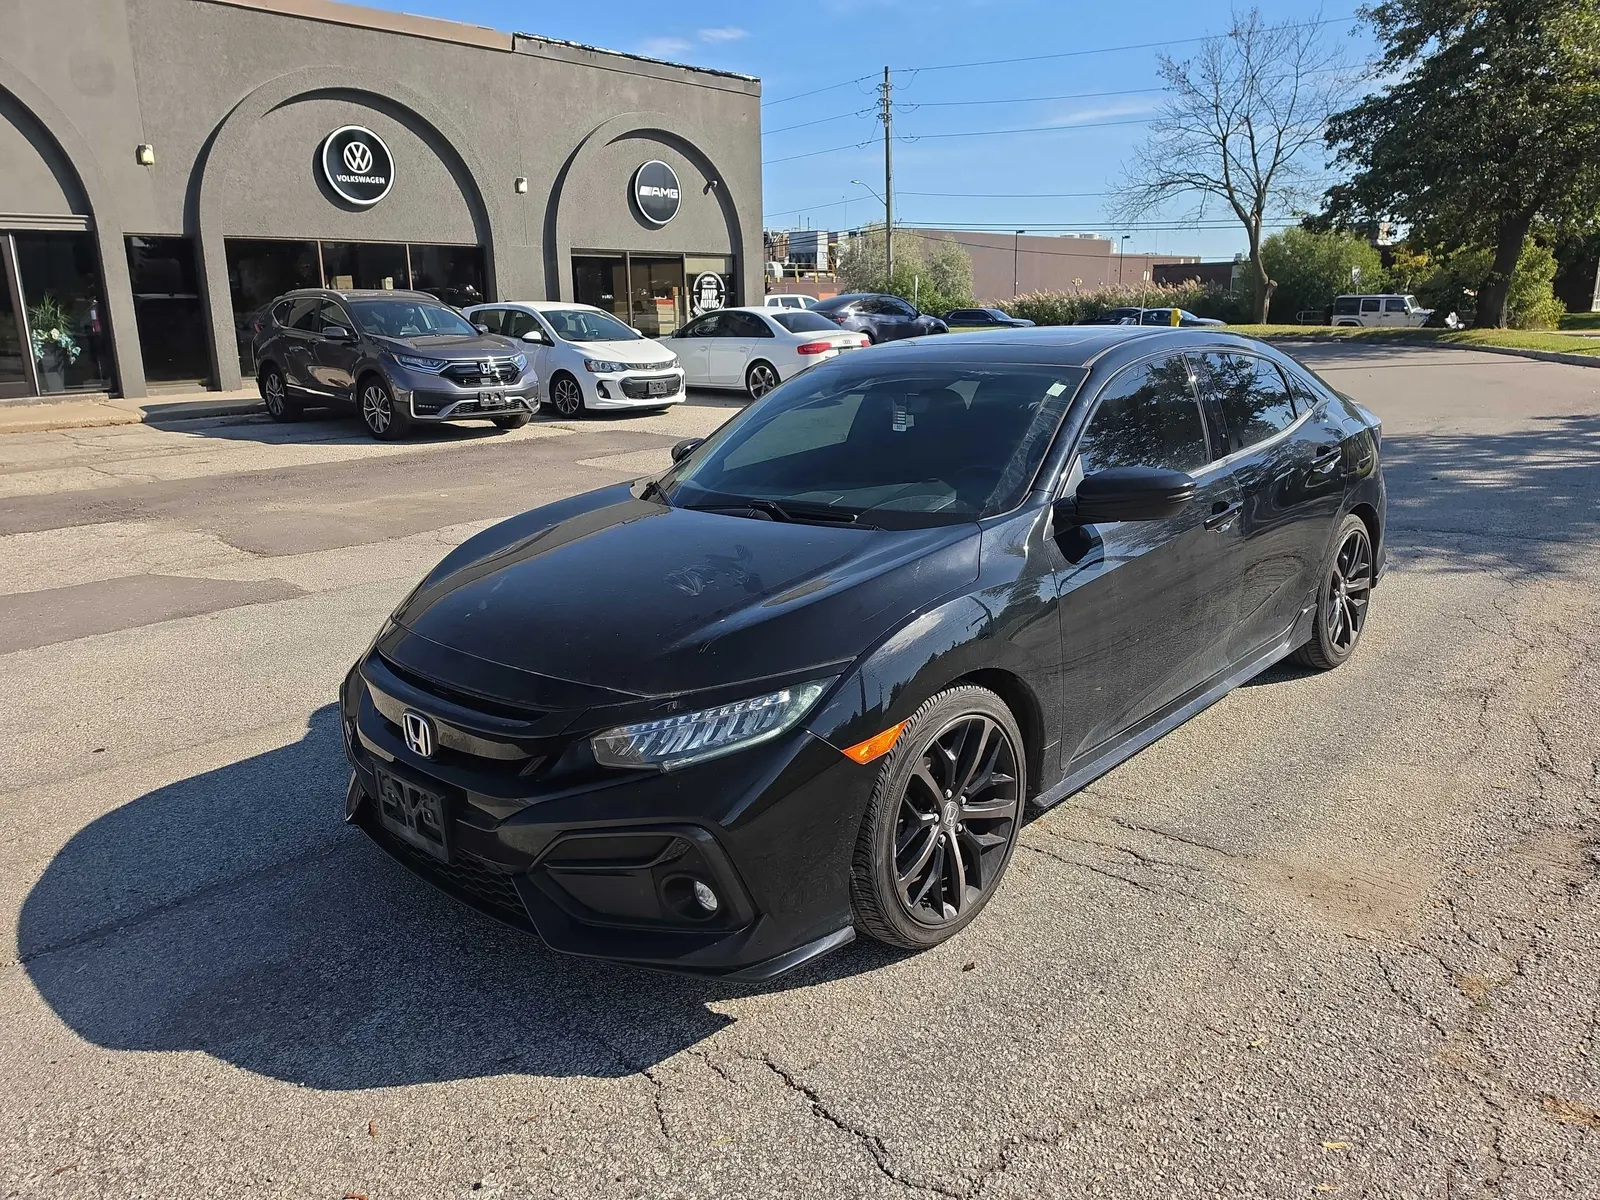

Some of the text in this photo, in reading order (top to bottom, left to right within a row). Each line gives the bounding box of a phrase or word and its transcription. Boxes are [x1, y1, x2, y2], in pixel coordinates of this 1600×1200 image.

[336, 175, 385, 184] VOLKSWAGEN
[652, 187, 678, 198] AMG
[701, 289, 718, 300] MVP
[700, 299, 720, 309] AUTOS
